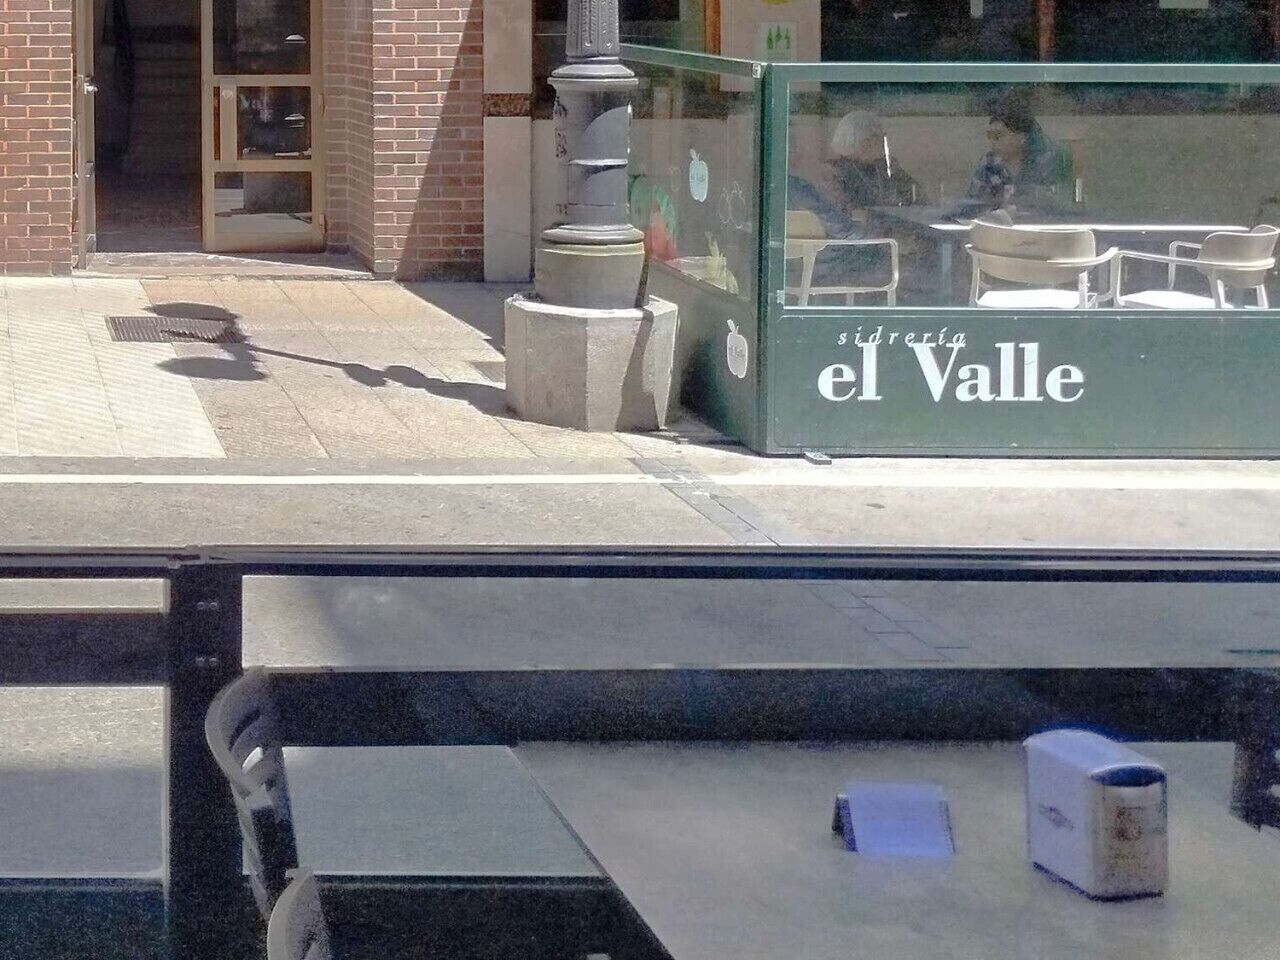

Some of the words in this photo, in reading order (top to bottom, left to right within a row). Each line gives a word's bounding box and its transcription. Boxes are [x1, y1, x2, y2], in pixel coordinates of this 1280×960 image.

[837, 326, 967, 345] sidrería
[817, 342, 882, 402] el
[908, 342, 1084, 402] Valle
